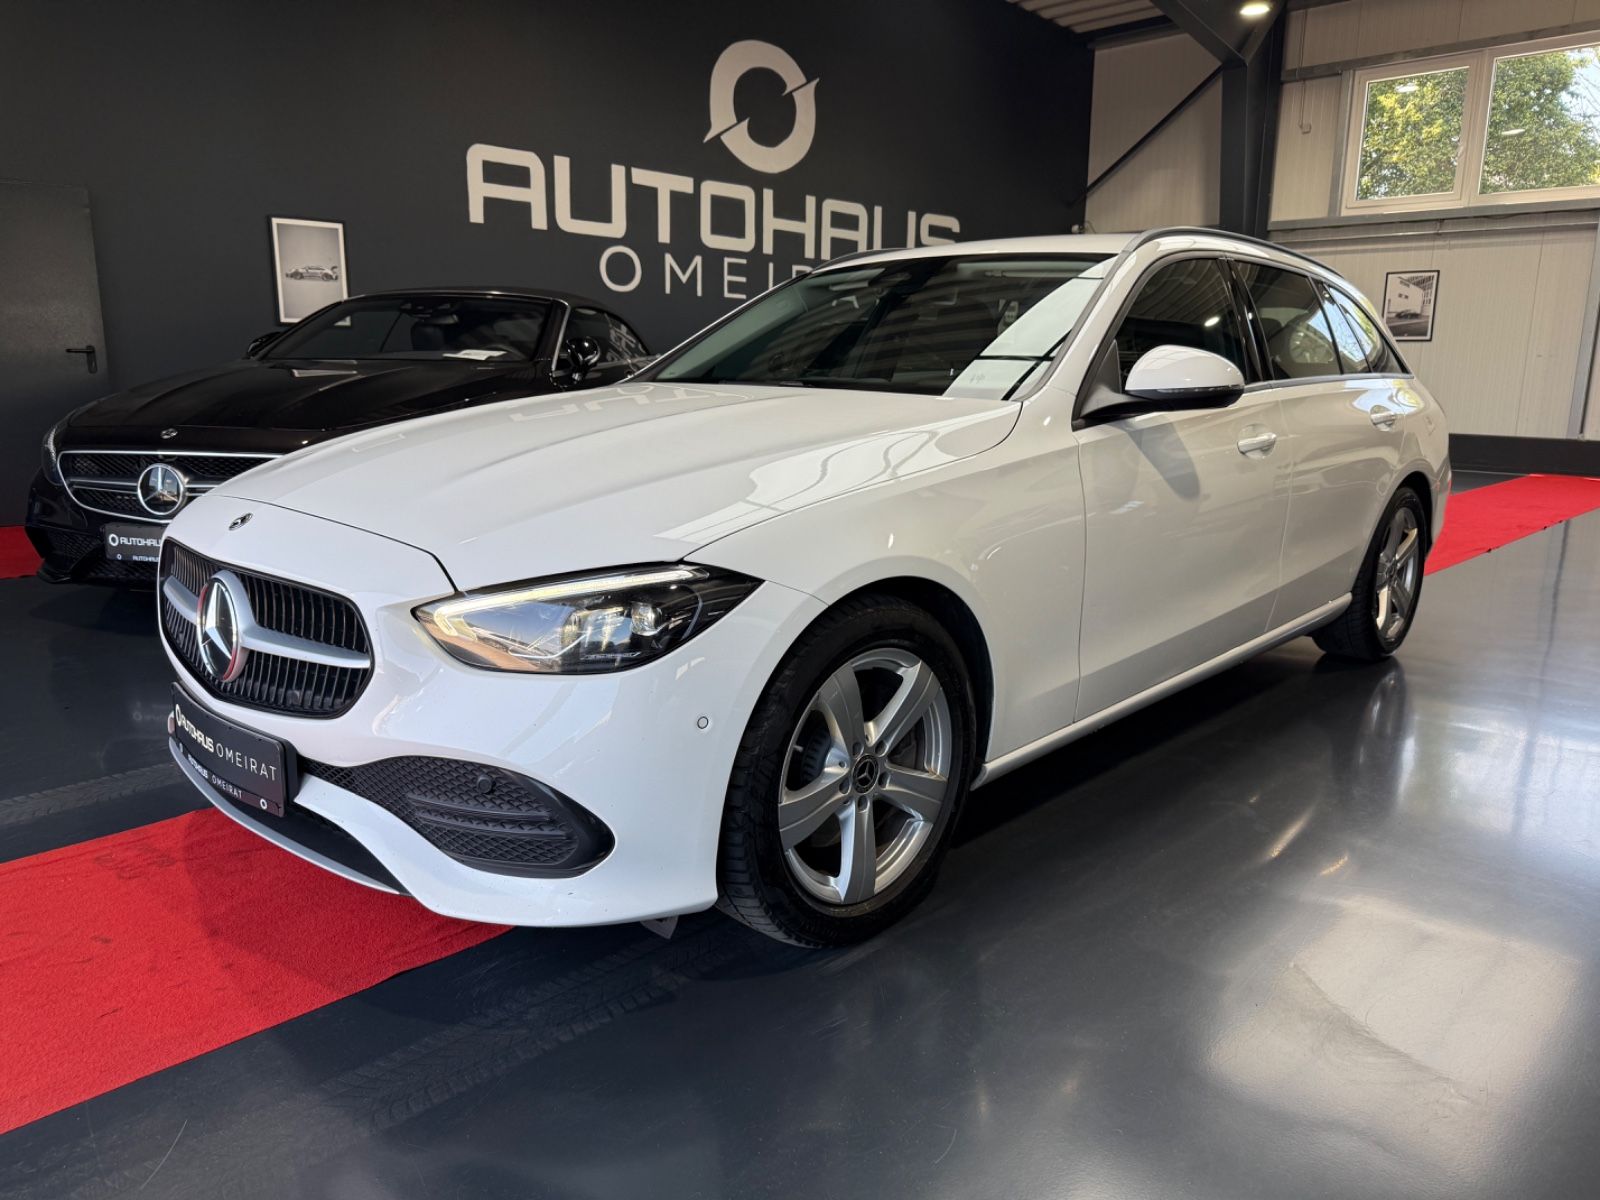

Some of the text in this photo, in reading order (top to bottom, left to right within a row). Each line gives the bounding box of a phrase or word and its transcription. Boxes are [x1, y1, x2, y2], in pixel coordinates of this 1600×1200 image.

[466, 143, 960, 259] AUTOHAUS
[216, 743, 277, 781] OMEIRAT
[211, 774, 242, 799] OMEIRAT
